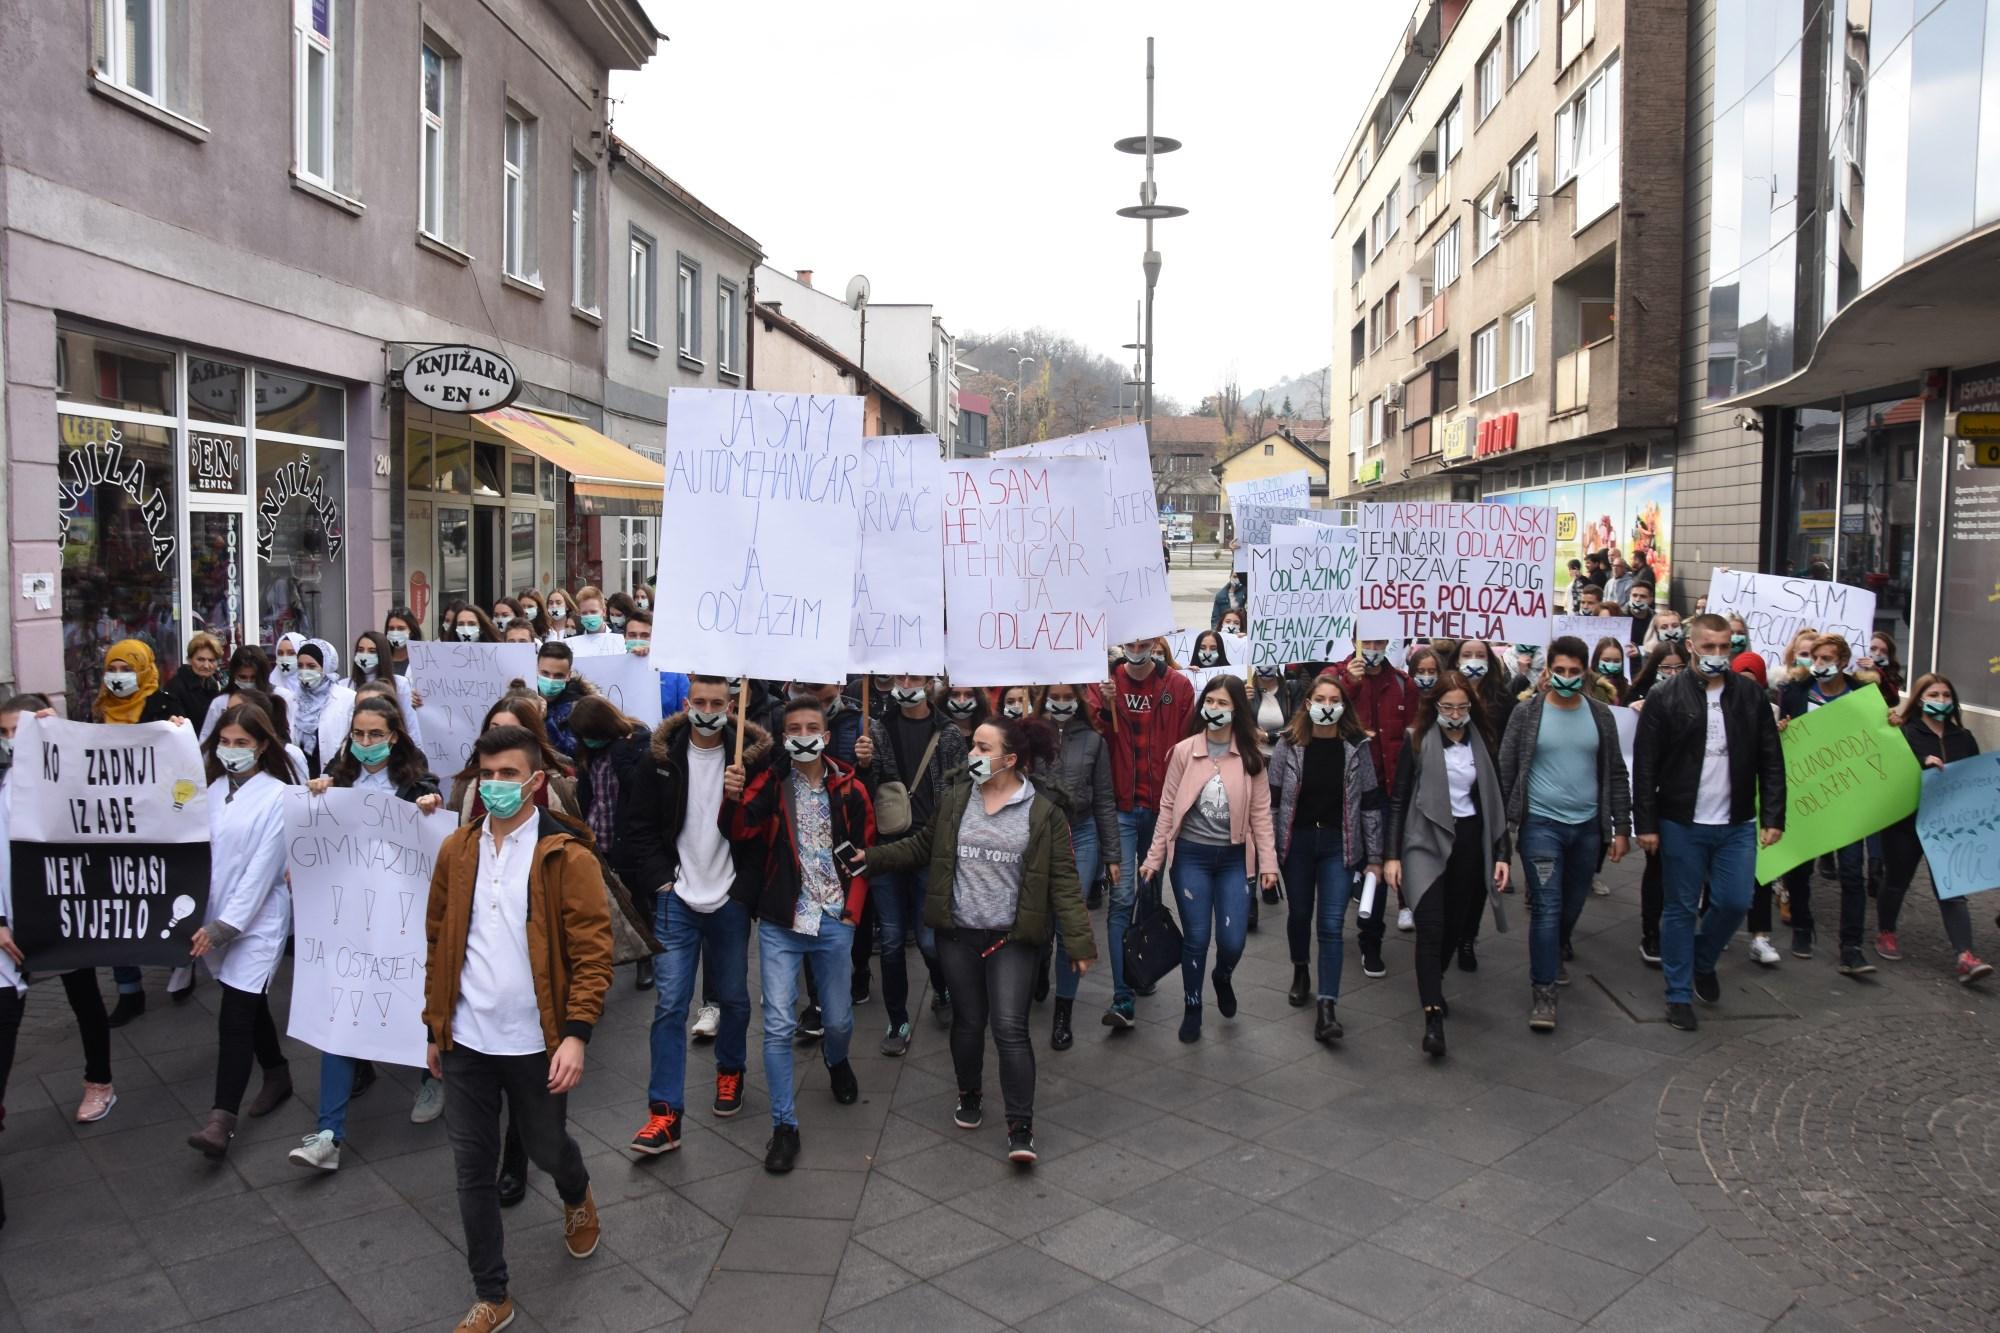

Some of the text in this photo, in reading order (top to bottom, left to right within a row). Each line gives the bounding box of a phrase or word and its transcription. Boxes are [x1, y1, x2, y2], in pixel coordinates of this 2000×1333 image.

[415, 350, 511, 385] KNJIŽARA
[720, 393, 835, 452] JA SAM
[375, 454, 391, 476] 20
[669, 449, 858, 509] AUTOMEHANIČAR
[862, 439, 914, 489] SAM
[199, 479, 233, 490] ZENICA
[945, 467, 1051, 507] JA SAM
[256, 453, 343, 563] KNJIŽARA
[943, 505, 1077, 545] HEMIJSKI
[1255, 506, 1275, 520] SMO
[1363, 503, 1384, 529] MI
[1391, 503, 1551, 535] ARHITEKTONSKI
[1315, 528, 1334, 545] MI
[1360, 527, 1547, 562] TEHNIČARI ODLAZIMO
[731, 547, 764, 592] JA
[944, 542, 1090, 578] TEHNIČAR
[1252, 547, 1279, 572] MI
[1290, 546, 1332, 571] SMO
[1361, 554, 1544, 590] IZ DRŽAVE ZBOG
[1014, 576, 1054, 613] JA
[1269, 567, 1352, 593] ODLAZIMO
[1721, 573, 1848, 622] JA SAM
[696, 590, 822, 641] ODLAZIM
[1360, 580, 1547, 619] LOŠEG POLOŽAJA
[848, 611, 923, 649] AZIM
[977, 611, 1107, 651] ODLAZIM
[1250, 614, 1351, 642] MEHANIZMA
[1397, 611, 1505, 641] TEMELJA
[410, 644, 504, 677] JA SAM
[1124, 693, 1153, 709] WA
[42, 741, 157, 786] KO ZADNJI
[426, 741, 449, 761] JA
[1794, 766, 1862, 817] ODLAZIM
[69, 797, 137, 834] IZAĐE
[295, 790, 421, 844] JA SAM
[109, 854, 166, 896] UGASI
[59, 898, 150, 940] SVJETLO
[301, 938, 325, 968] JA
